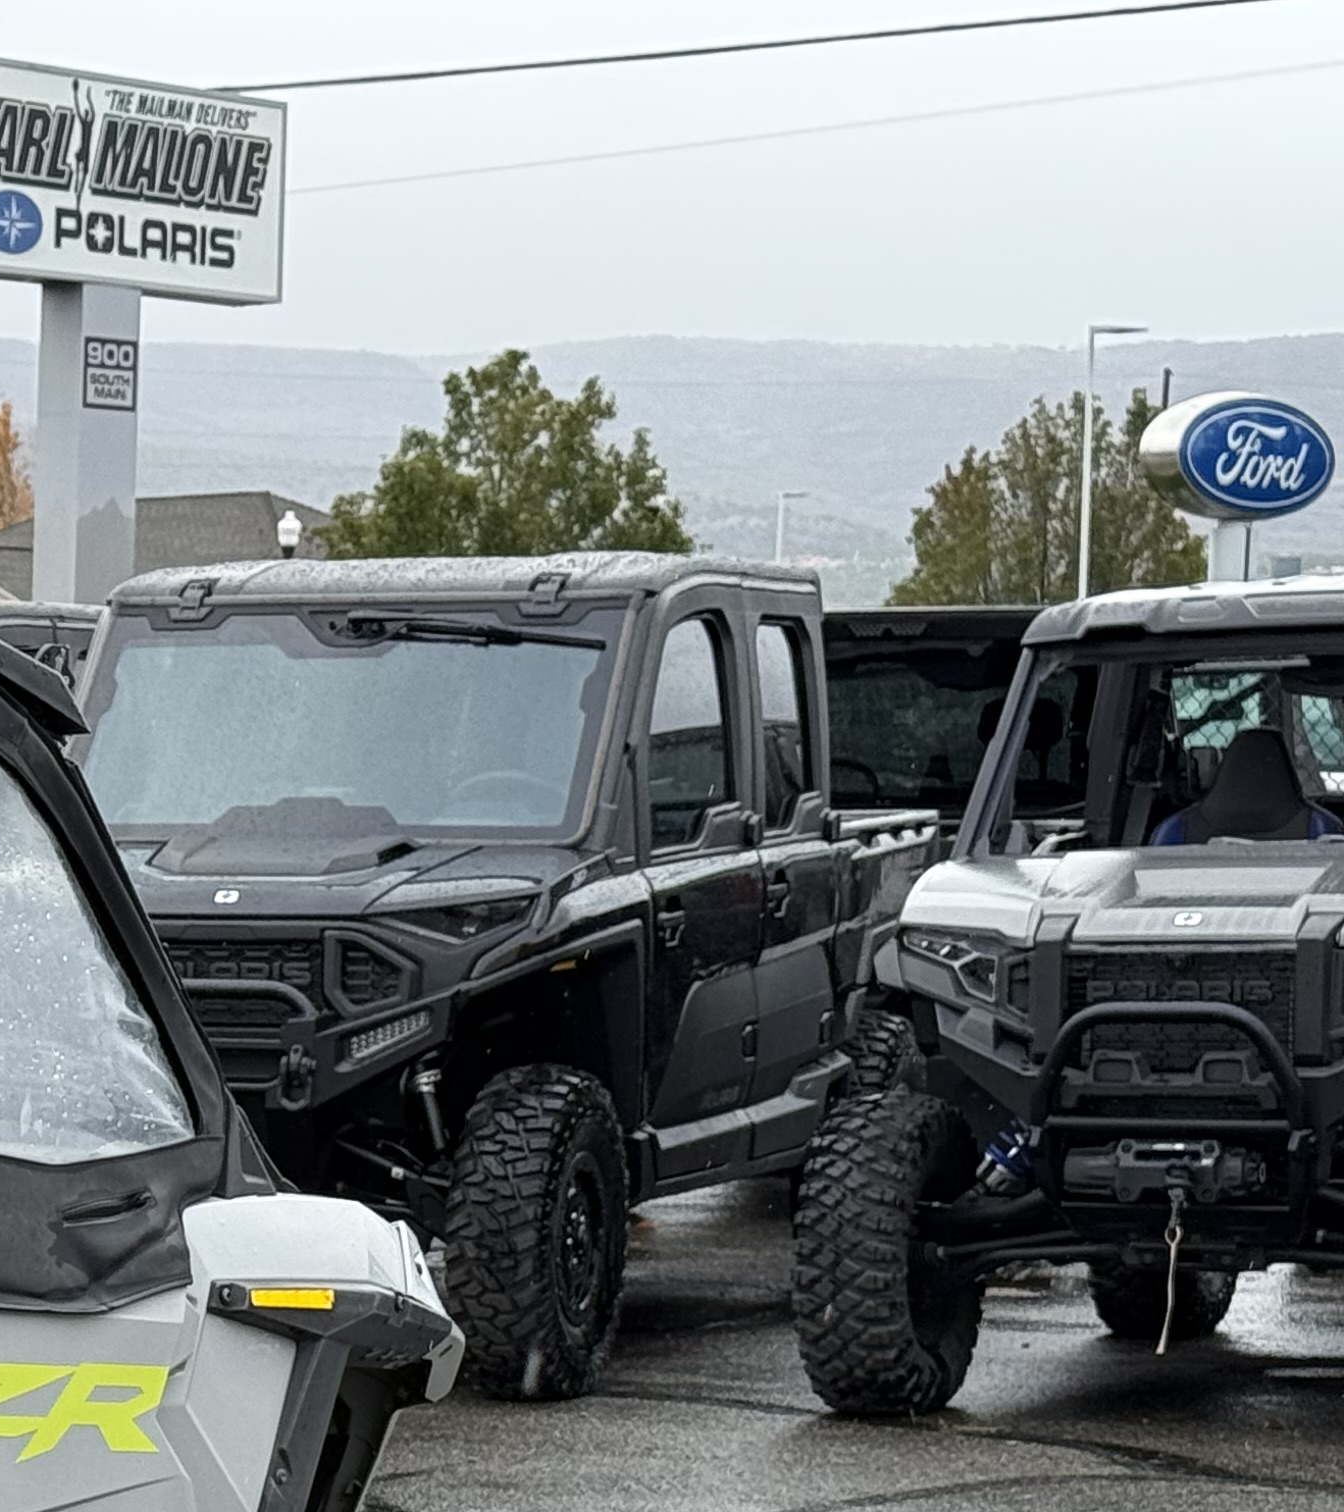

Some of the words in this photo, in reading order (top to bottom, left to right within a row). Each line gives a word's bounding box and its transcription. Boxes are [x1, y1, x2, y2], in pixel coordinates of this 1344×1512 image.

[135, 93, 195, 123] MAILMAN
[90, 113, 272, 216] MALONE
[54, 206, 235, 269] POLARIS
[87, 342, 134, 367] 900
[90, 373, 130, 387] SOUTH
[94, 386, 127, 401] MAIN
[1216, 419, 1309, 491] Ford
